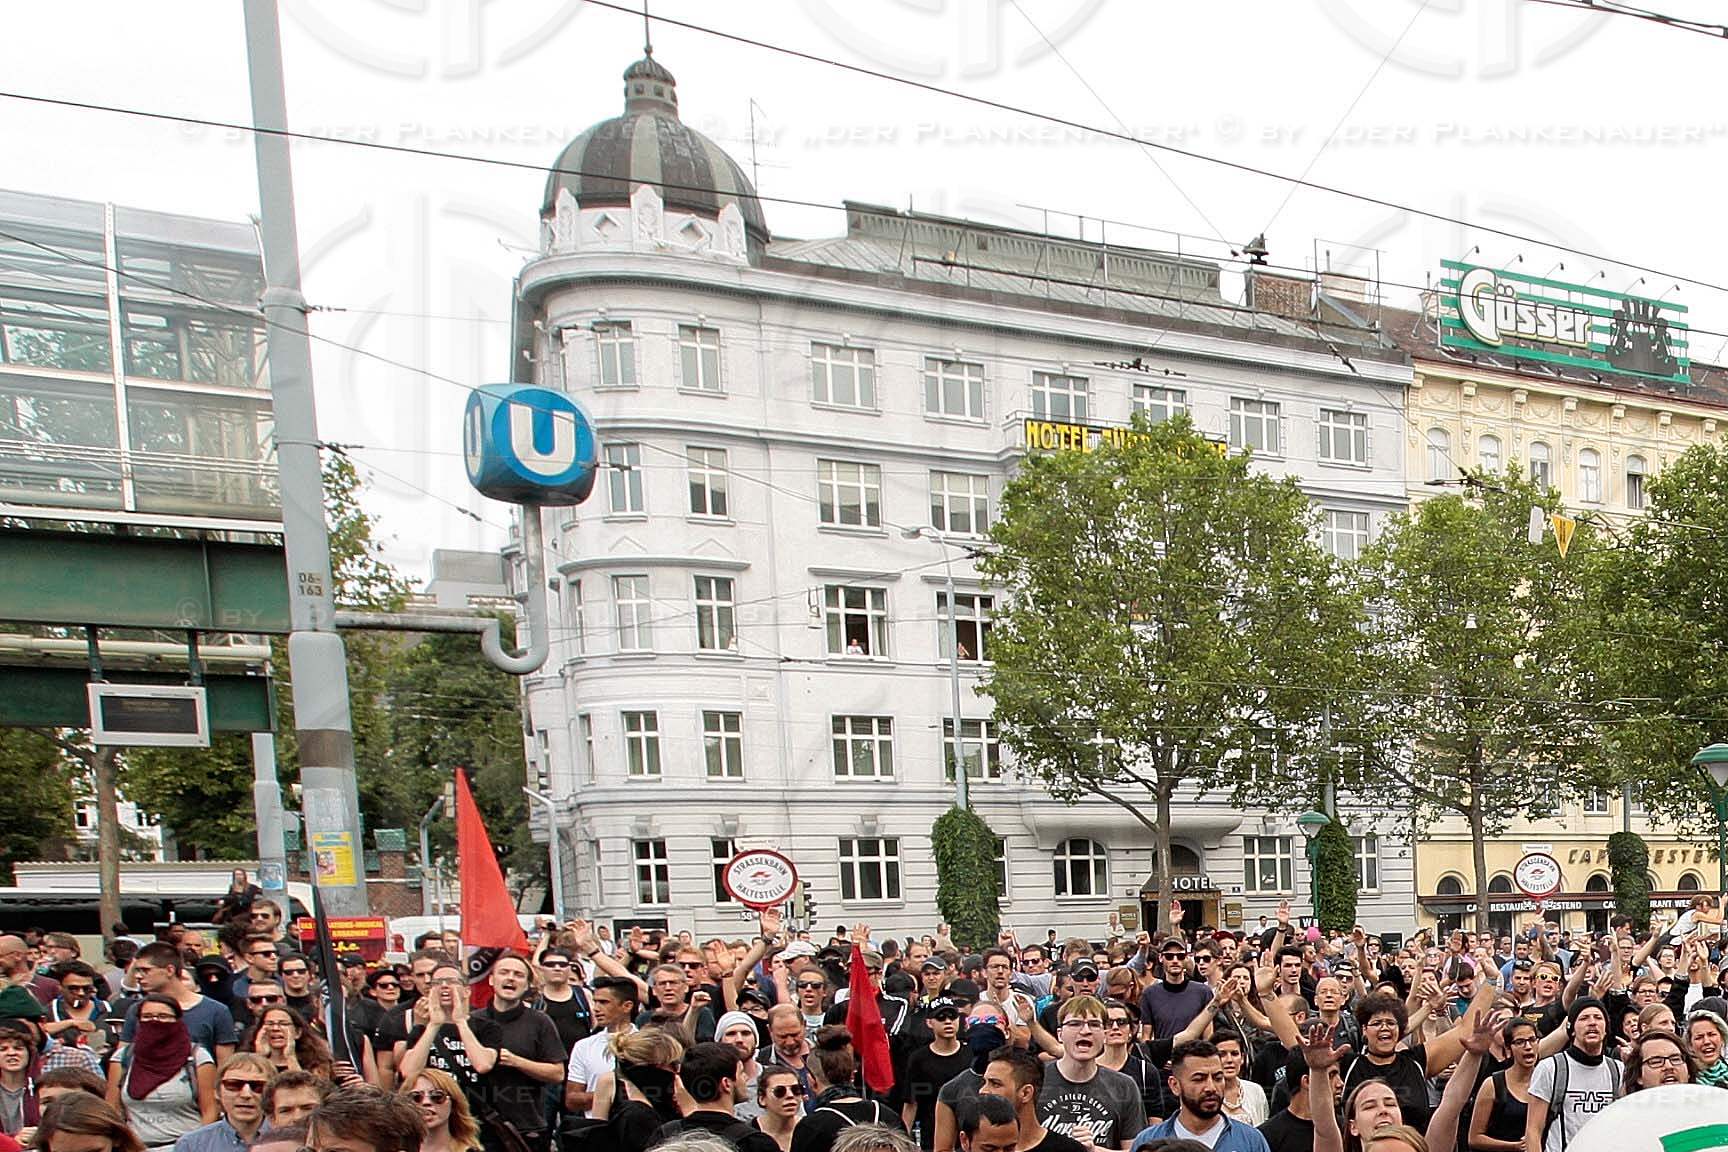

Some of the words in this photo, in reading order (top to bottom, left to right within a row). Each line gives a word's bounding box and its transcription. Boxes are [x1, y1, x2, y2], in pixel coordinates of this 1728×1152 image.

[1459, 267, 1591, 346] Gösser
[510, 402, 576, 476] U
[733, 858, 788, 875] STRASSENBAHN
[736, 883, 786, 899] HALTESTELLE
